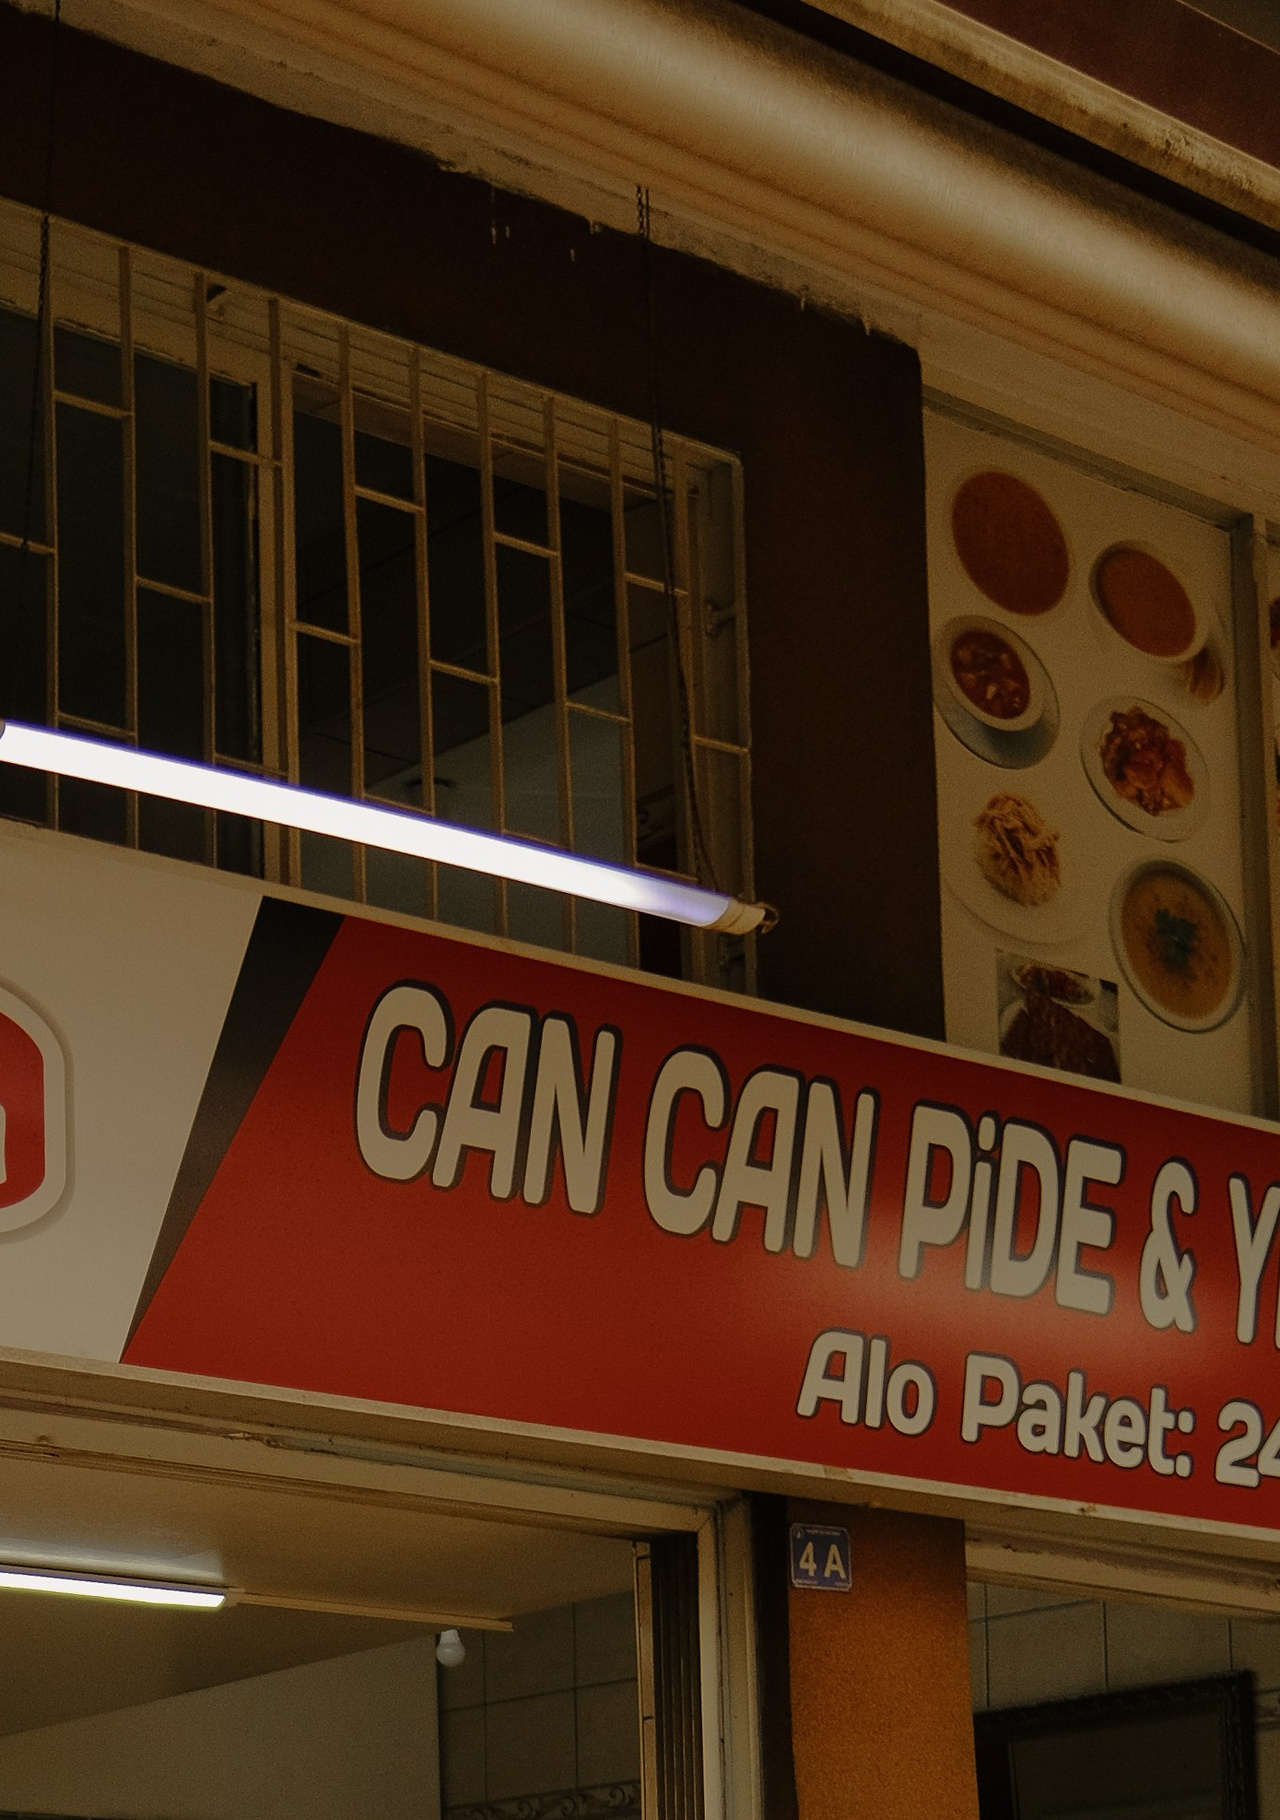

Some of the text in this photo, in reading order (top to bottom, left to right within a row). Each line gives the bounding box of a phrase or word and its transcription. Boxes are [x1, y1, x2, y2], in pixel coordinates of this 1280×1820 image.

[356, 980, 620, 1216] CAN
[645, 1046, 878, 1269] CAN
[1138, 1155, 1198, 1334] &
[1228, 1172, 1280, 1350] Y
[797, 1327, 937, 1438] Alo
[961, 1351, 1194, 1480] Paket:
